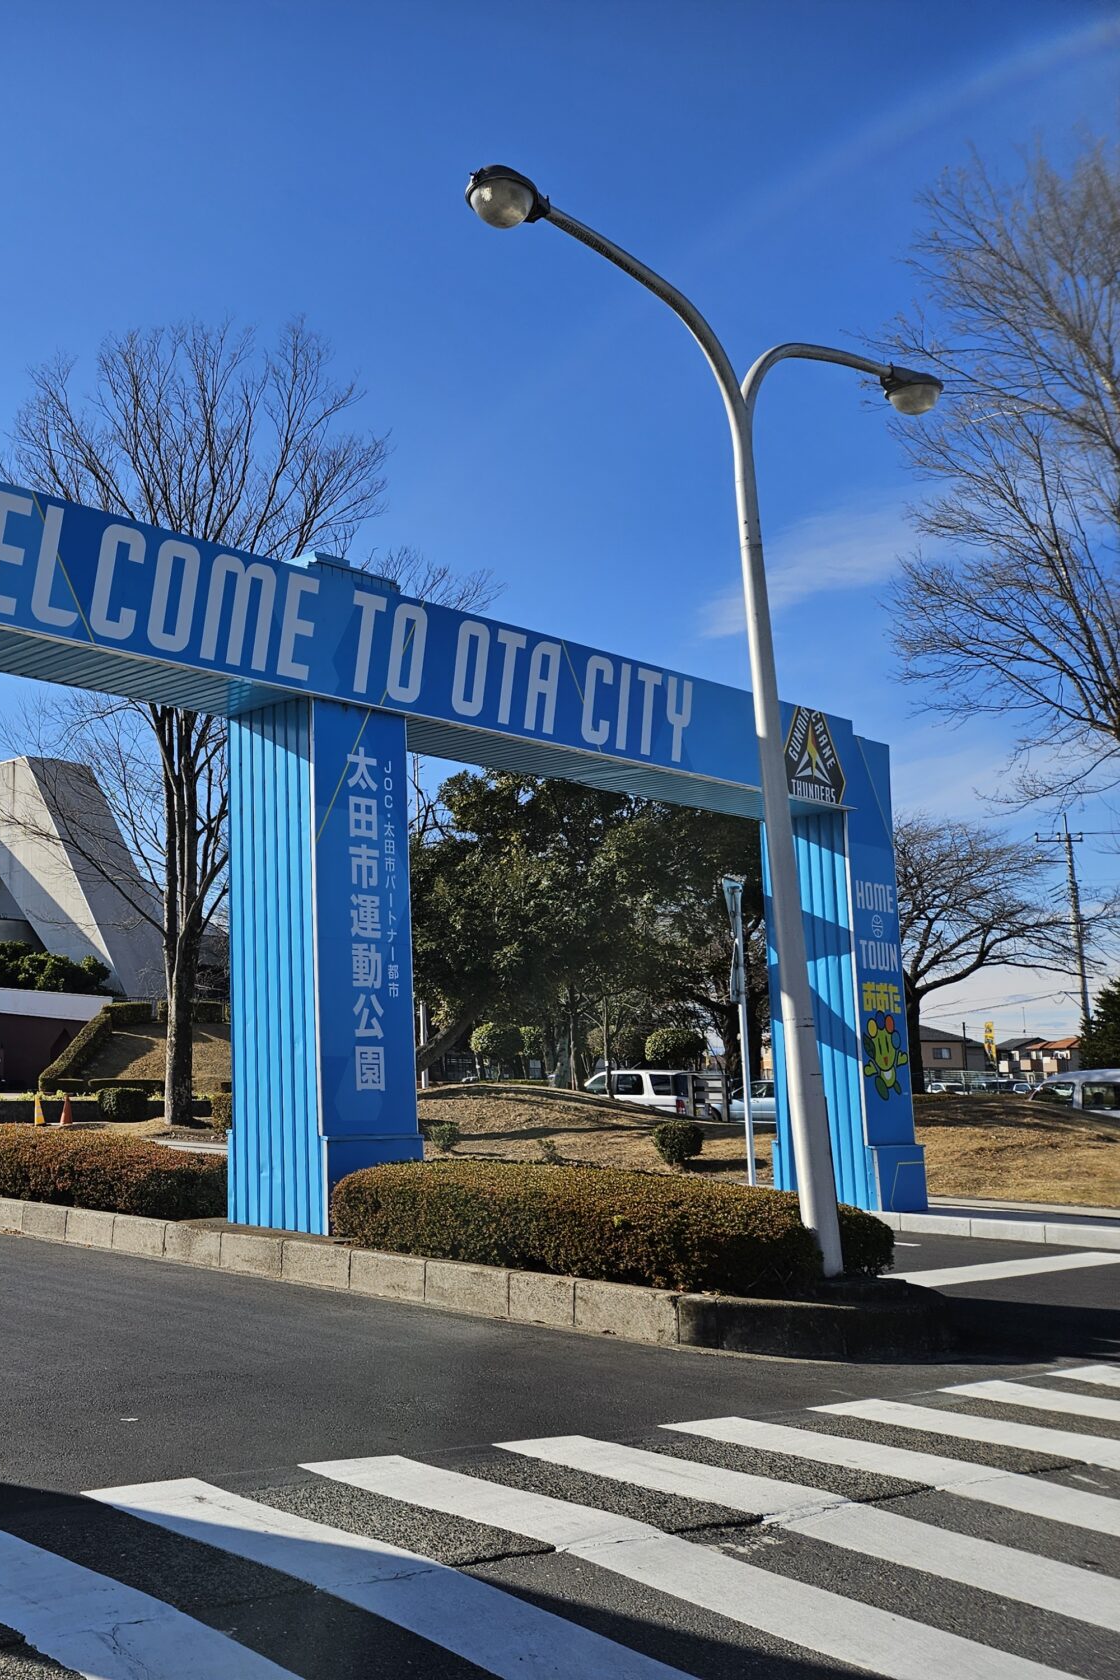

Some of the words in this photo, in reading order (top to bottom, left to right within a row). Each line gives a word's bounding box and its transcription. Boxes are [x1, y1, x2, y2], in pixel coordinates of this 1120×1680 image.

[353, 590, 428, 703] TO
[452, 620, 562, 734] OTA
[581, 655, 693, 762] CITY
[788, 707, 810, 761] GUNMA
[810, 710, 836, 769] CRANE
[791, 779, 836, 804] THUNDERS
[347, 746, 385, 1091] 太田市運動公園
[855, 880, 894, 914] HOME
[859, 939, 898, 972] TOWN
